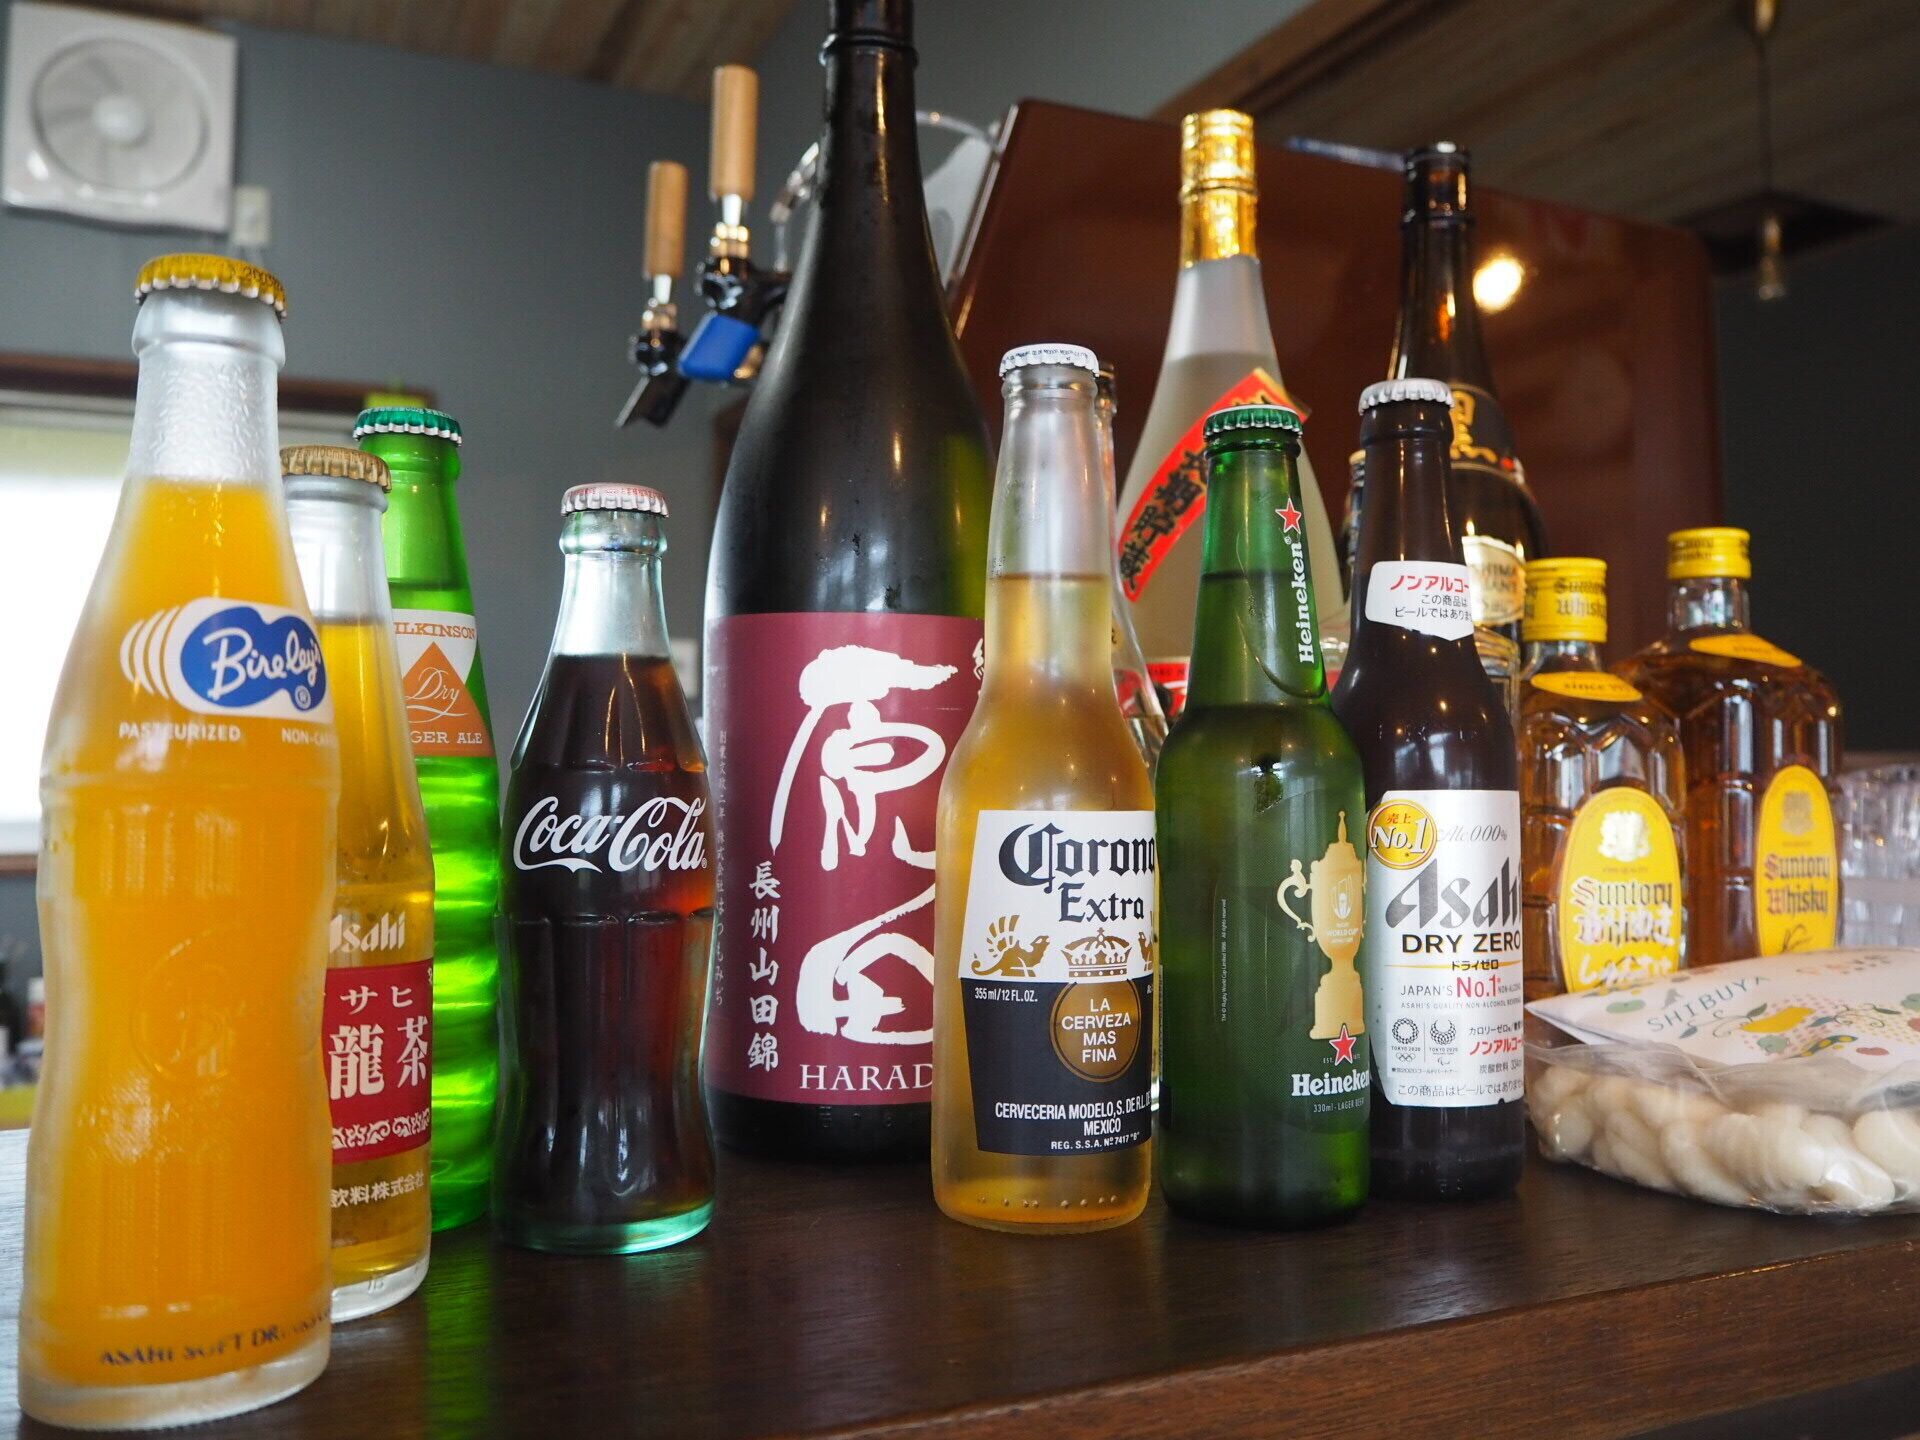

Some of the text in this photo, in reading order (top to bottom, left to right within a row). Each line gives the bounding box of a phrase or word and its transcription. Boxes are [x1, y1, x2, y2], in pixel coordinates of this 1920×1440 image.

[1290, 541, 1315, 664] Heineken
[1395, 606, 1473, 623] ビールではありま
[1421, 593, 1469, 607] この商品は
[392, 621, 476, 640] ILKINSON
[202, 627, 323, 701] Bireley's
[405, 666, 468, 724] Dry
[118, 721, 242, 742] PASTEURIZED
[410, 730, 484, 744] GER ALE
[512, 795, 707, 874] Coca-Cola
[1370, 817, 1428, 855] No.1
[998, 821, 1155, 895] Corona
[1764, 853, 1831, 883] Suntory
[1057, 882, 1145, 924] Extra
[1572, 878, 1673, 909] Suntory
[1766, 884, 1829, 919] Whisky
[1402, 930, 1522, 954] DRY ZERO
[747, 859, 782, 1073] 長州山田錦
[1451, 958, 1500, 971] ドライゼロ
[339, 984, 415, 1016] サヒ
[1400, 984, 1453, 996] JAPAN'S
[1646, 975, 1772, 1033] SHIBUYA
[1089, 997, 1111, 1013] LA
[1061, 1013, 1132, 1031] CERVEZA
[1082, 1030, 1117, 1047] MAS
[327, 1014, 429, 1101] 龍茶
[1081, 1047, 1117, 1064] FINA
[799, 1063, 934, 1092] HARAD
[995, 1101, 1067, 1120] CERVECERIA
[1083, 1117, 1122, 1137] MEXICO
[1050, 1140, 1073, 1151] REG.
[1114, 1134, 1131, 1145] 7417
[330, 1169, 426, 1209] 飲料株式会社
